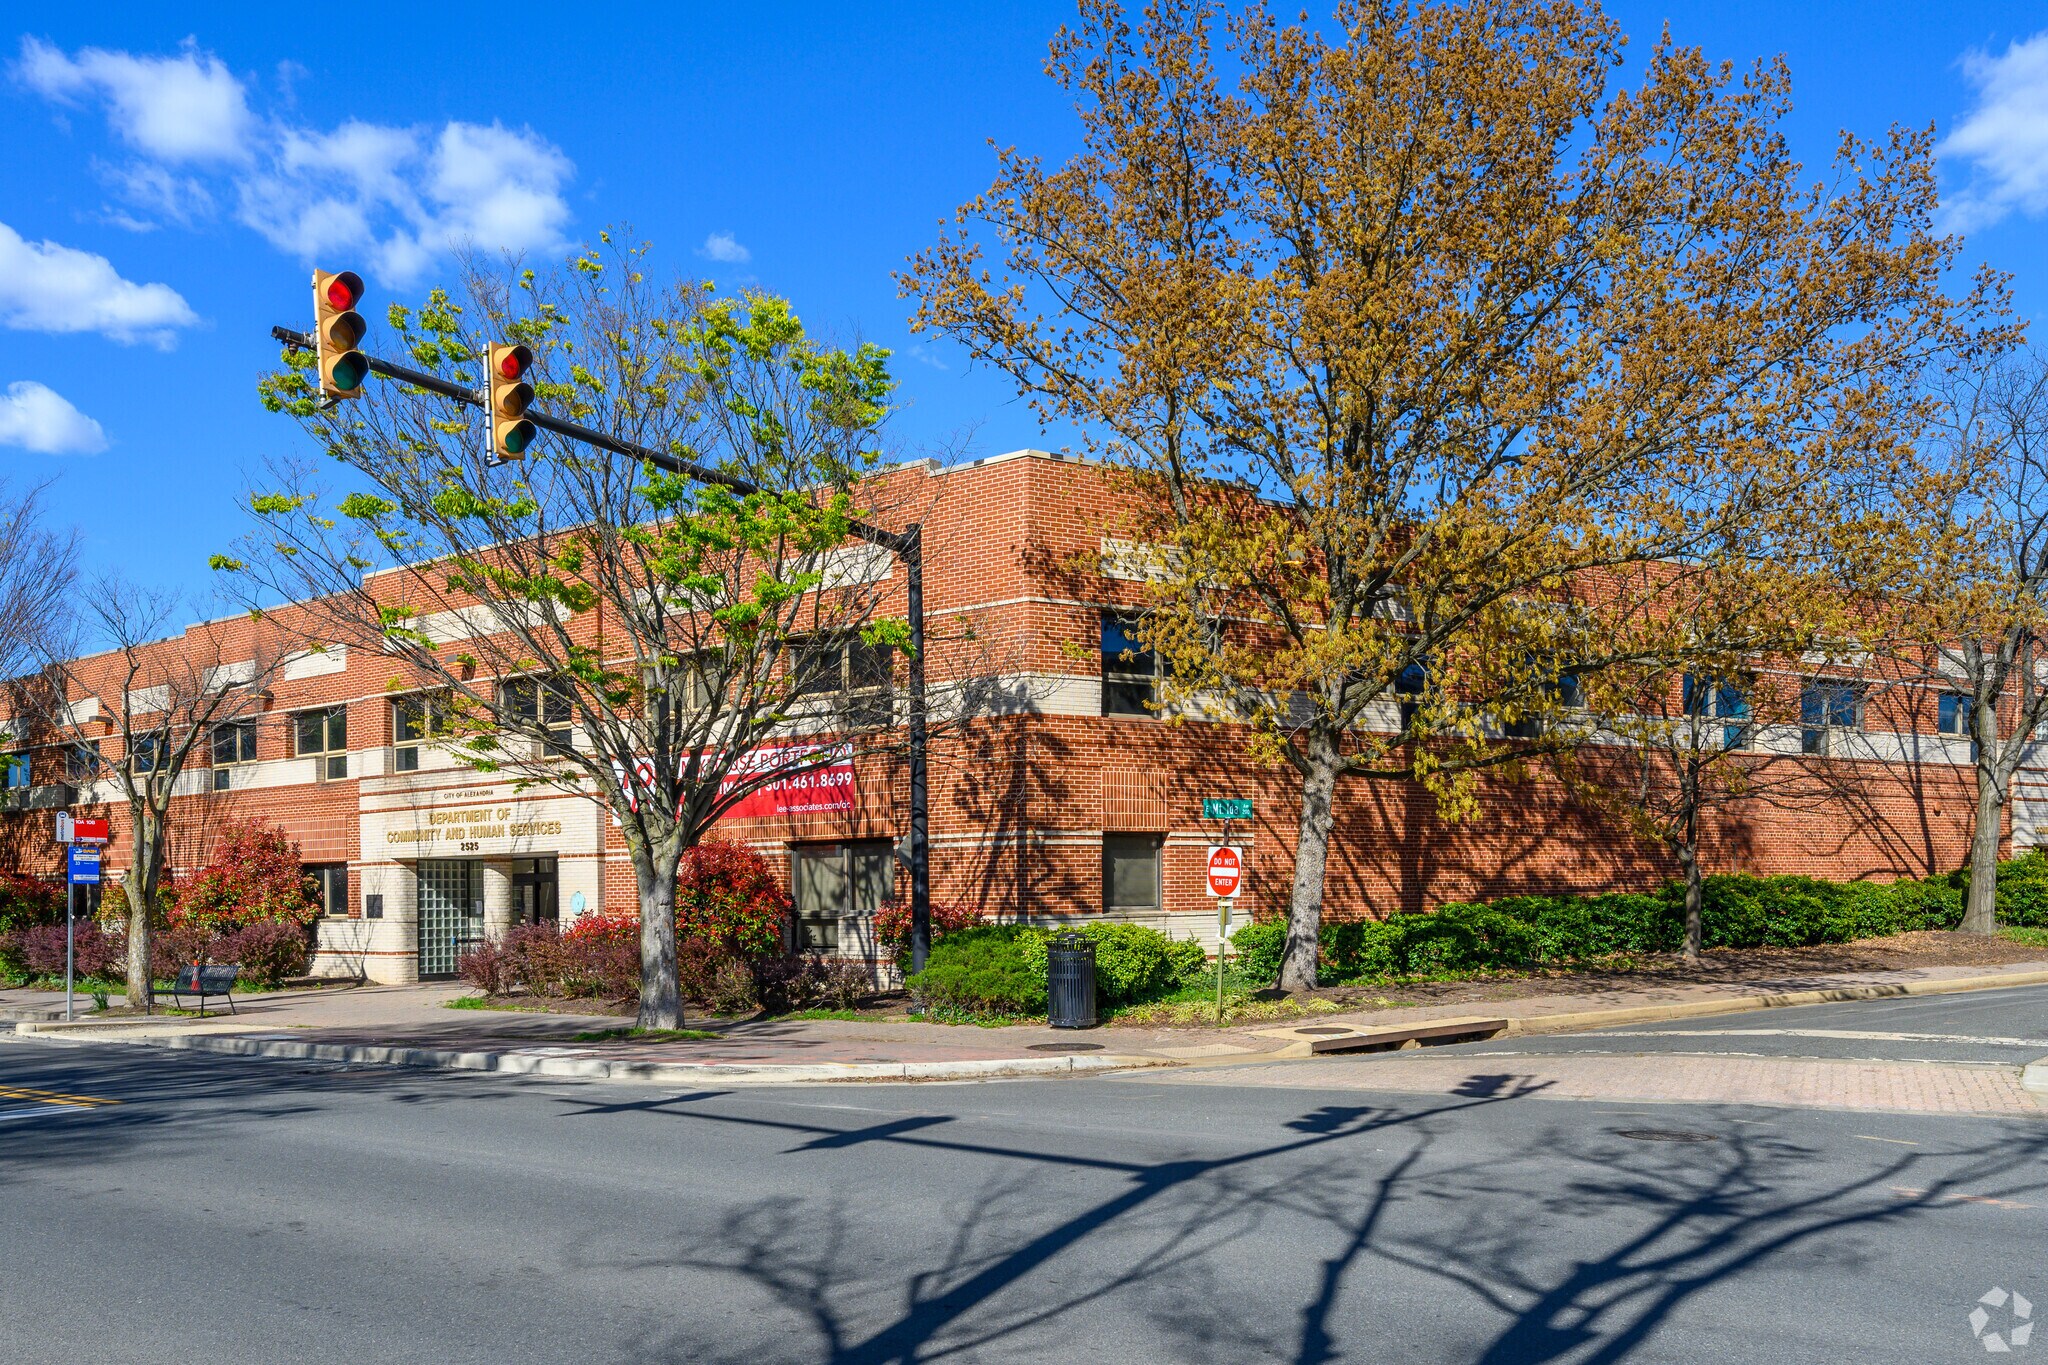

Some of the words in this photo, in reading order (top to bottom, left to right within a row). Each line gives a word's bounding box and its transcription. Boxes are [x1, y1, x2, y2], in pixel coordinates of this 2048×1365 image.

[464, 789, 494, 798] ALEXANDRIA
[1226, 803, 1239, 815] Ida
[428, 809, 493, 826] DEPARTMENT
[496, 807, 512, 821] OF
[387, 828, 442, 844] COMMUNITY
[445, 826, 465, 841] AND
[469, 825, 505, 839] HUMAN
[509, 821, 562, 837] SERVICES
[460, 842, 479, 851] 2525
[1214, 878, 1233, 886] ENTER
